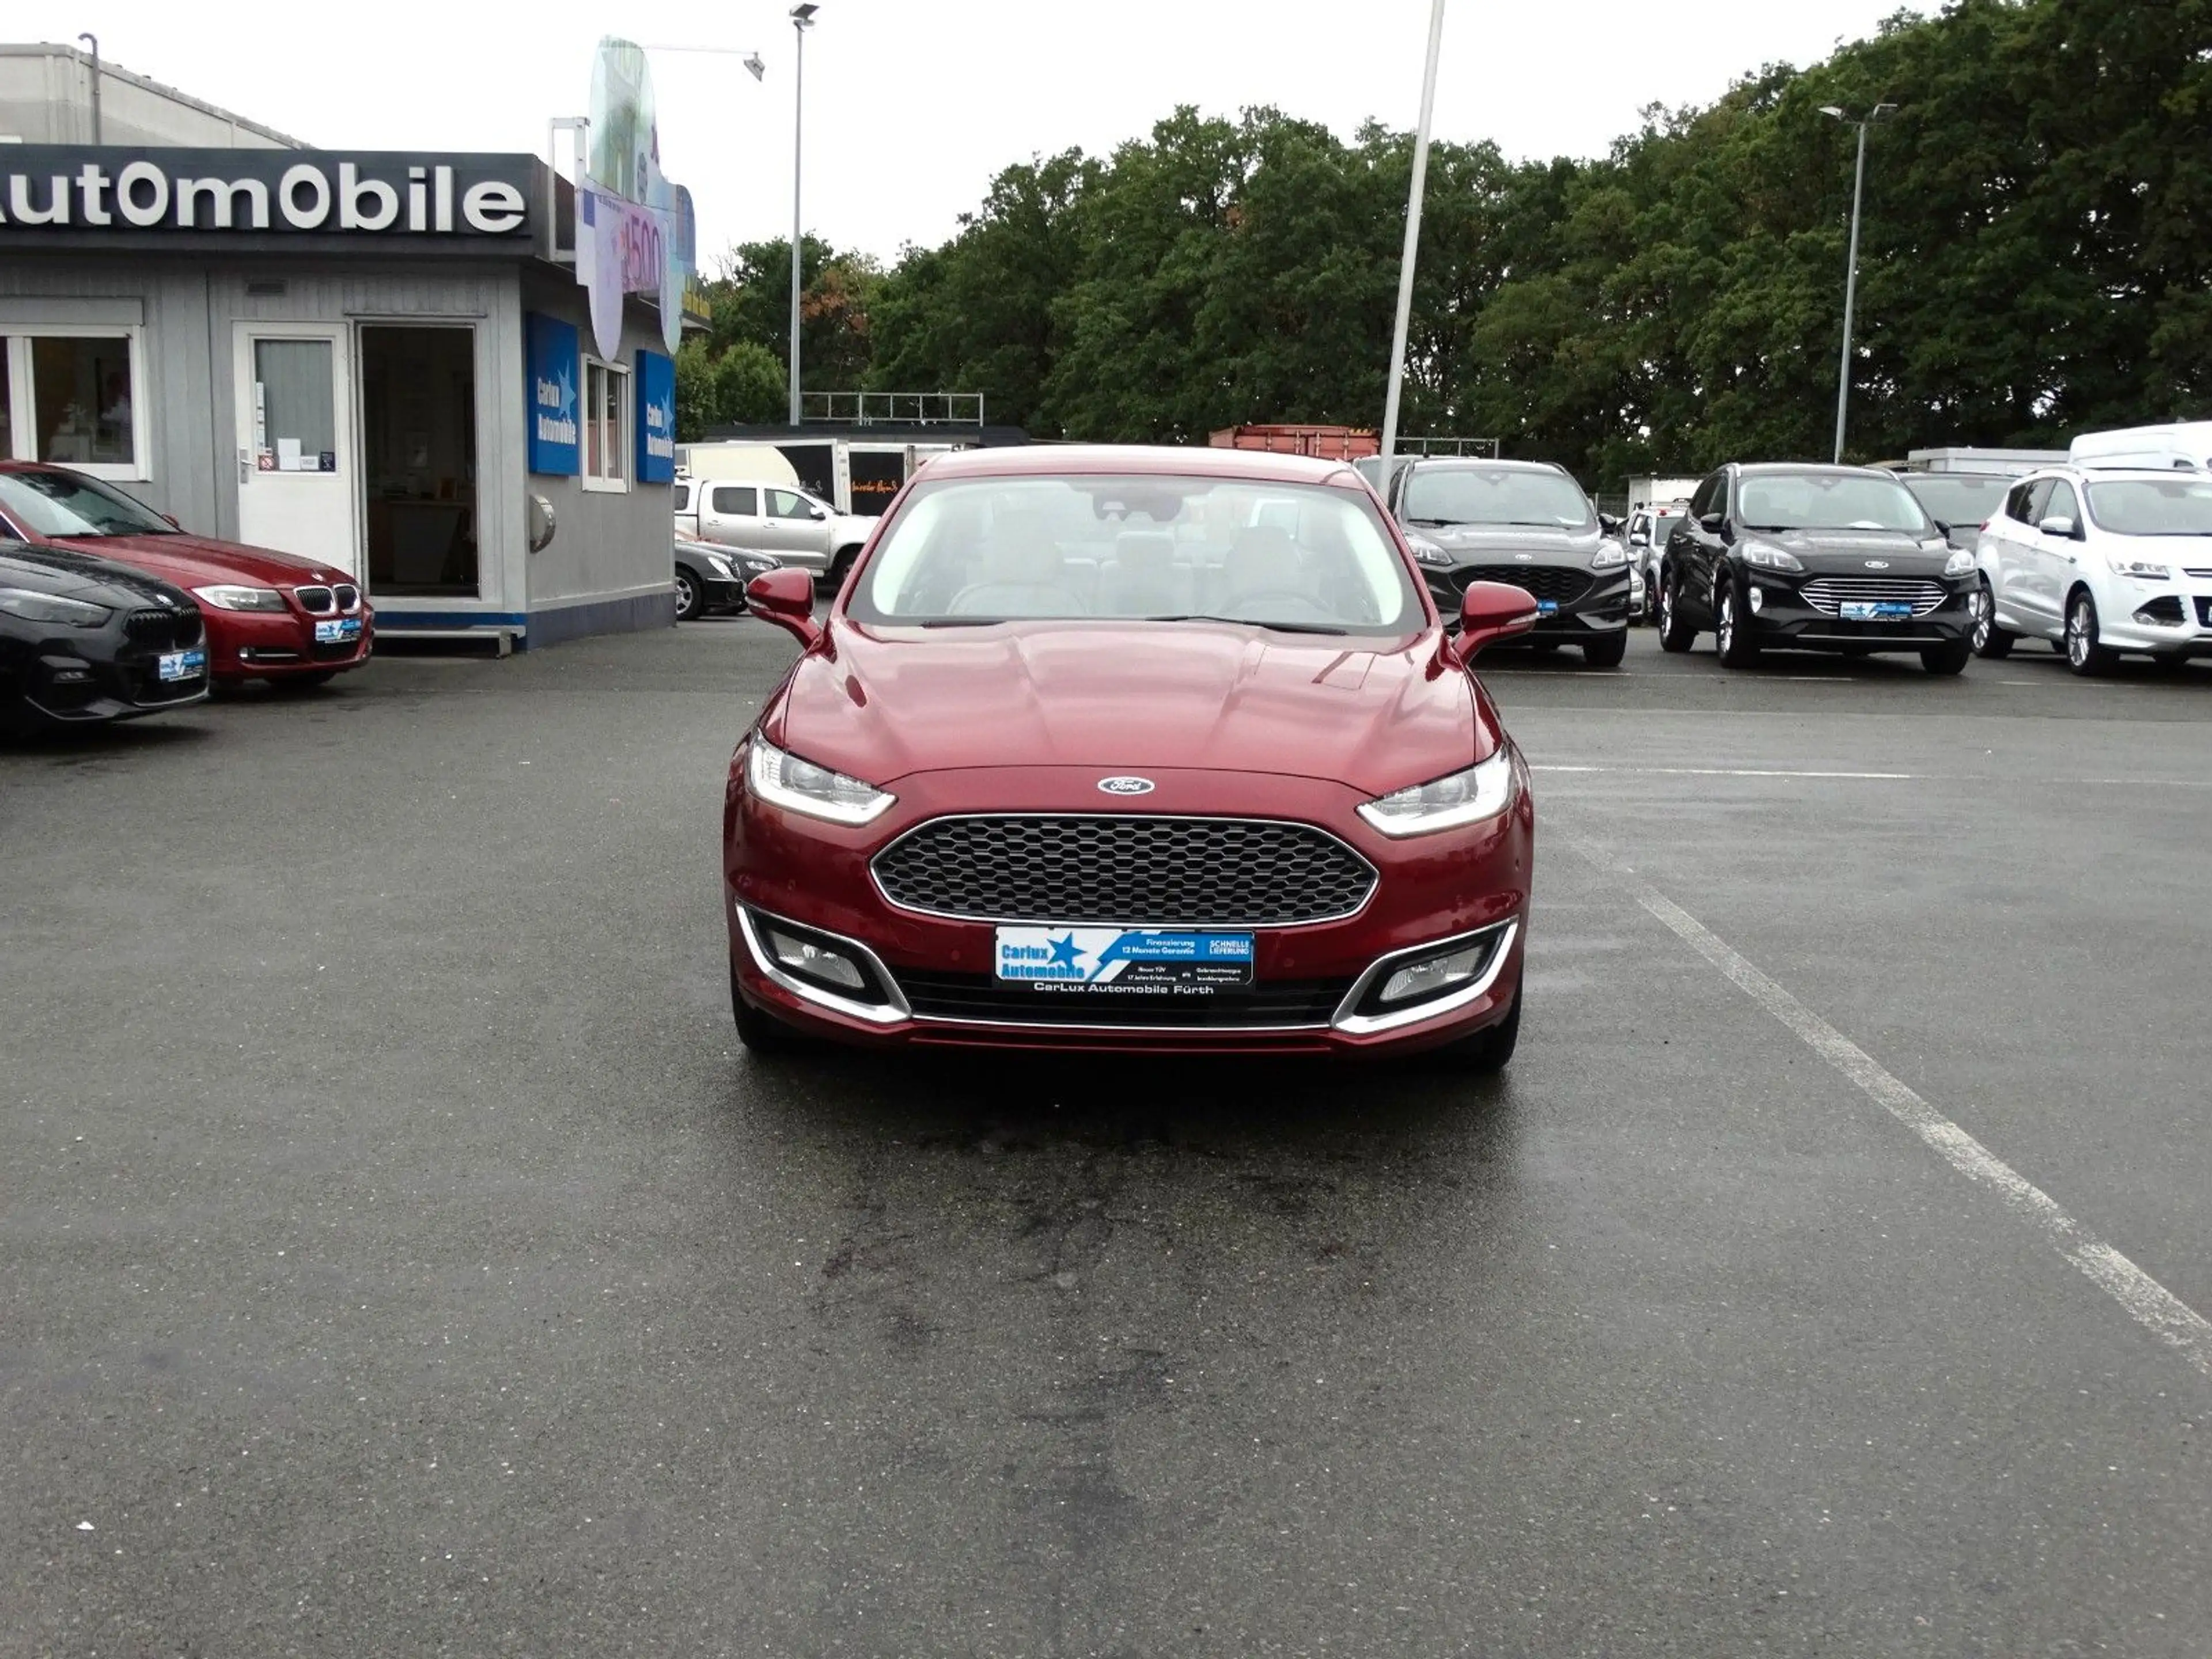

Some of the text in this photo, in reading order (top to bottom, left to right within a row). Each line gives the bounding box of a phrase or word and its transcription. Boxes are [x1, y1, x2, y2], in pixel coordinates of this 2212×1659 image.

[1110, 779, 1141, 790] Ford
[1209, 940, 1249, 948] SCHNELLE
[1002, 944, 1048, 960] Carlux
[1033, 982, 1214, 994] CarLux Automobile Fürth
